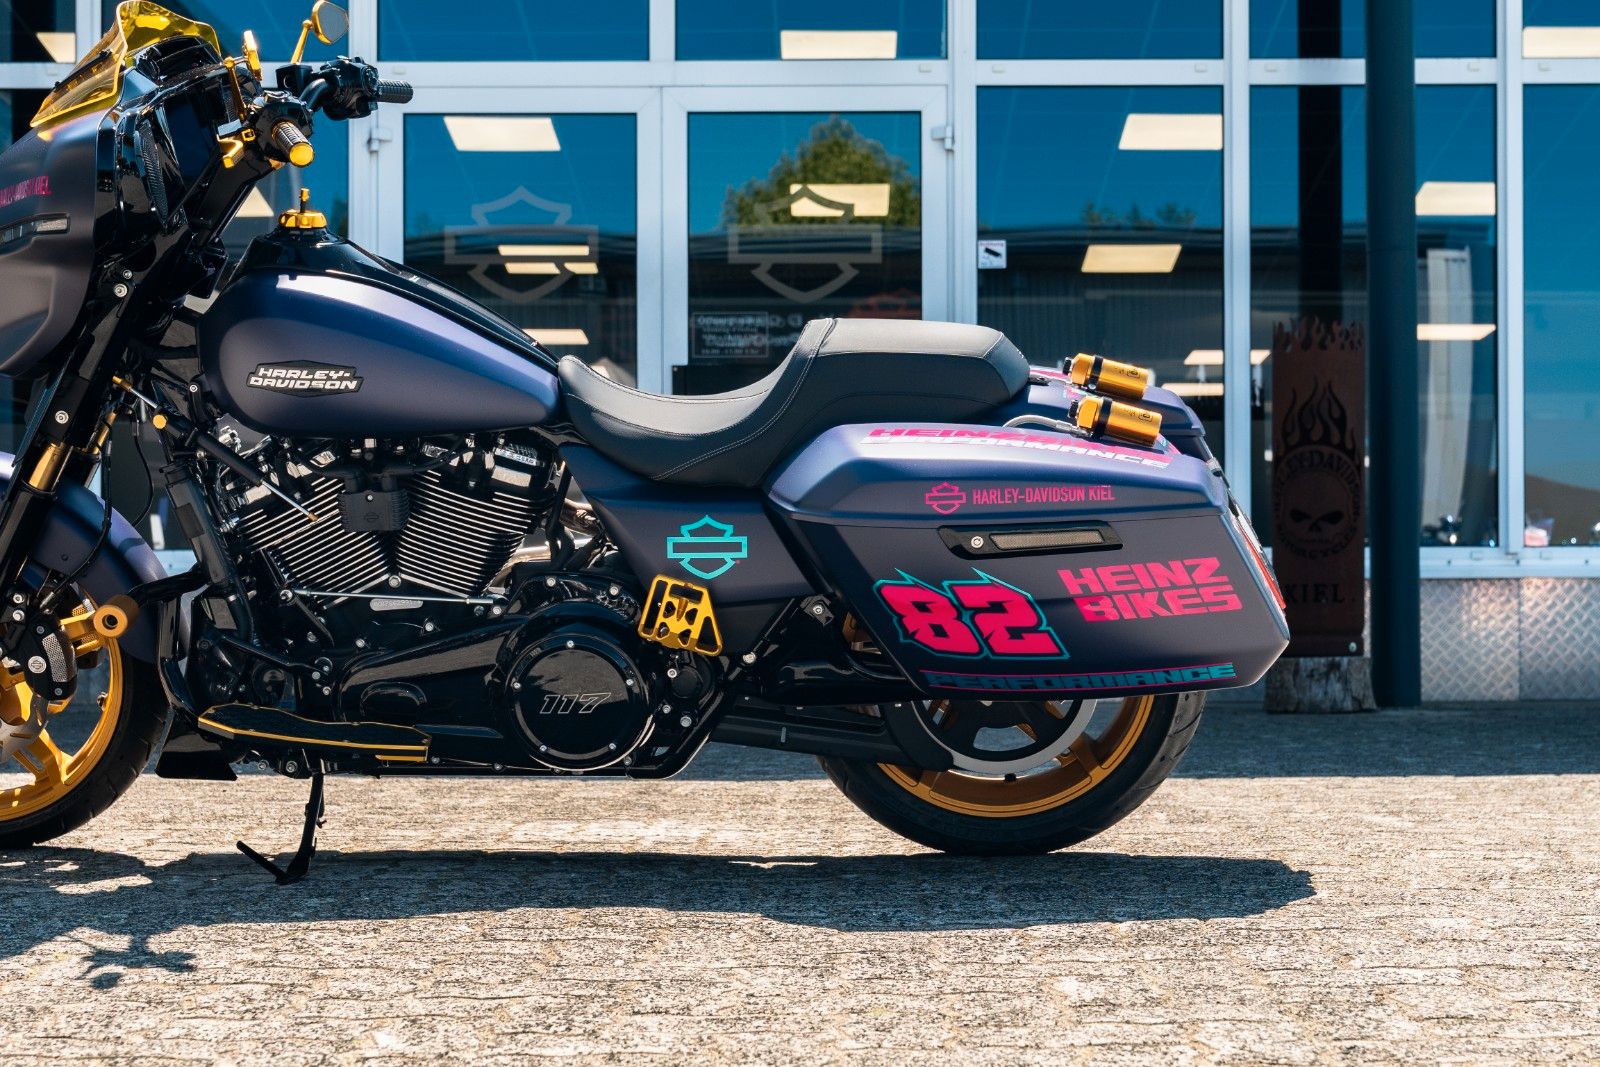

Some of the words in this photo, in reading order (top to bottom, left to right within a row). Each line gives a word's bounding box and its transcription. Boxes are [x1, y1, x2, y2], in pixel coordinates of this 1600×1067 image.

[249, 376, 358, 390] DAVIDSON
[258, 367, 351, 380] HARLEY-
[972, 486, 1085, 505] HARLEY-DAVIDSON
[1088, 484, 1116, 501] KIEL
[1056, 556, 1230, 596] HEINZ
[1073, 584, 1243, 622] BIKES
[876, 574, 1067, 659] 82
[926, 663, 1236, 690] PERFORMANCE
[540, 692, 612, 714] 117
